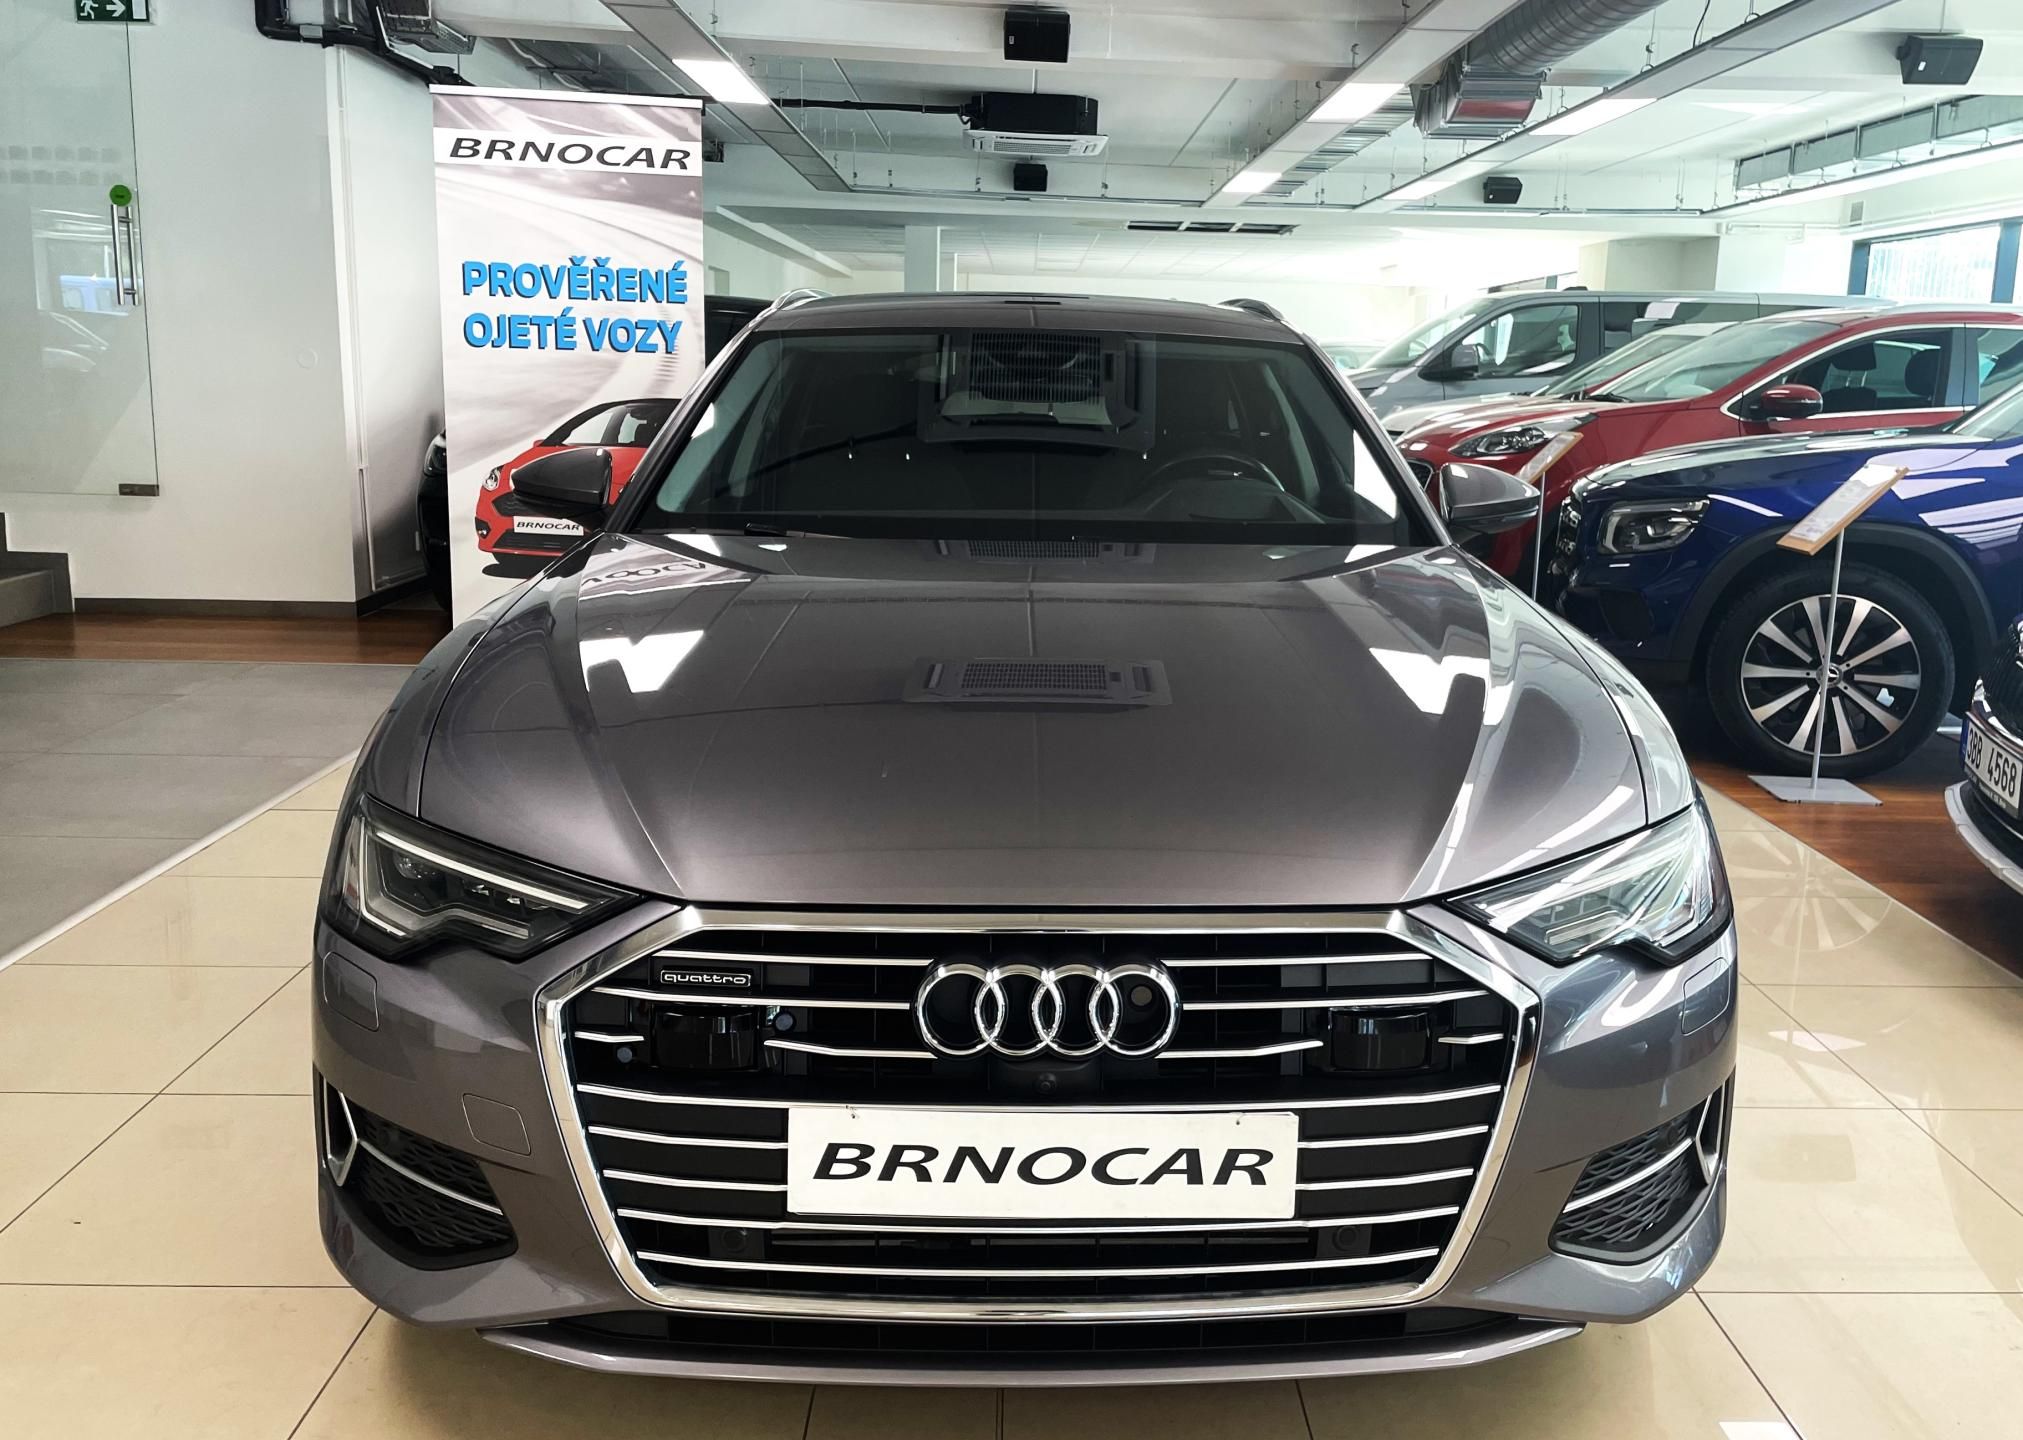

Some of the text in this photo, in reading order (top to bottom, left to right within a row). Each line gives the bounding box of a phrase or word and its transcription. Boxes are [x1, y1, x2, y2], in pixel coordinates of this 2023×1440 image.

[450, 137, 691, 170] BRNOCAR
[462, 255, 688, 304] PROVĚŘENÉ
[463, 307, 683, 354] OJETÉ VOZY
[516, 521, 581, 531] BRNOCAR
[1987, 746, 2017, 798] 4568
[664, 974, 747, 984] quattro
[812, 1142, 1275, 1187] BRNOCAR
